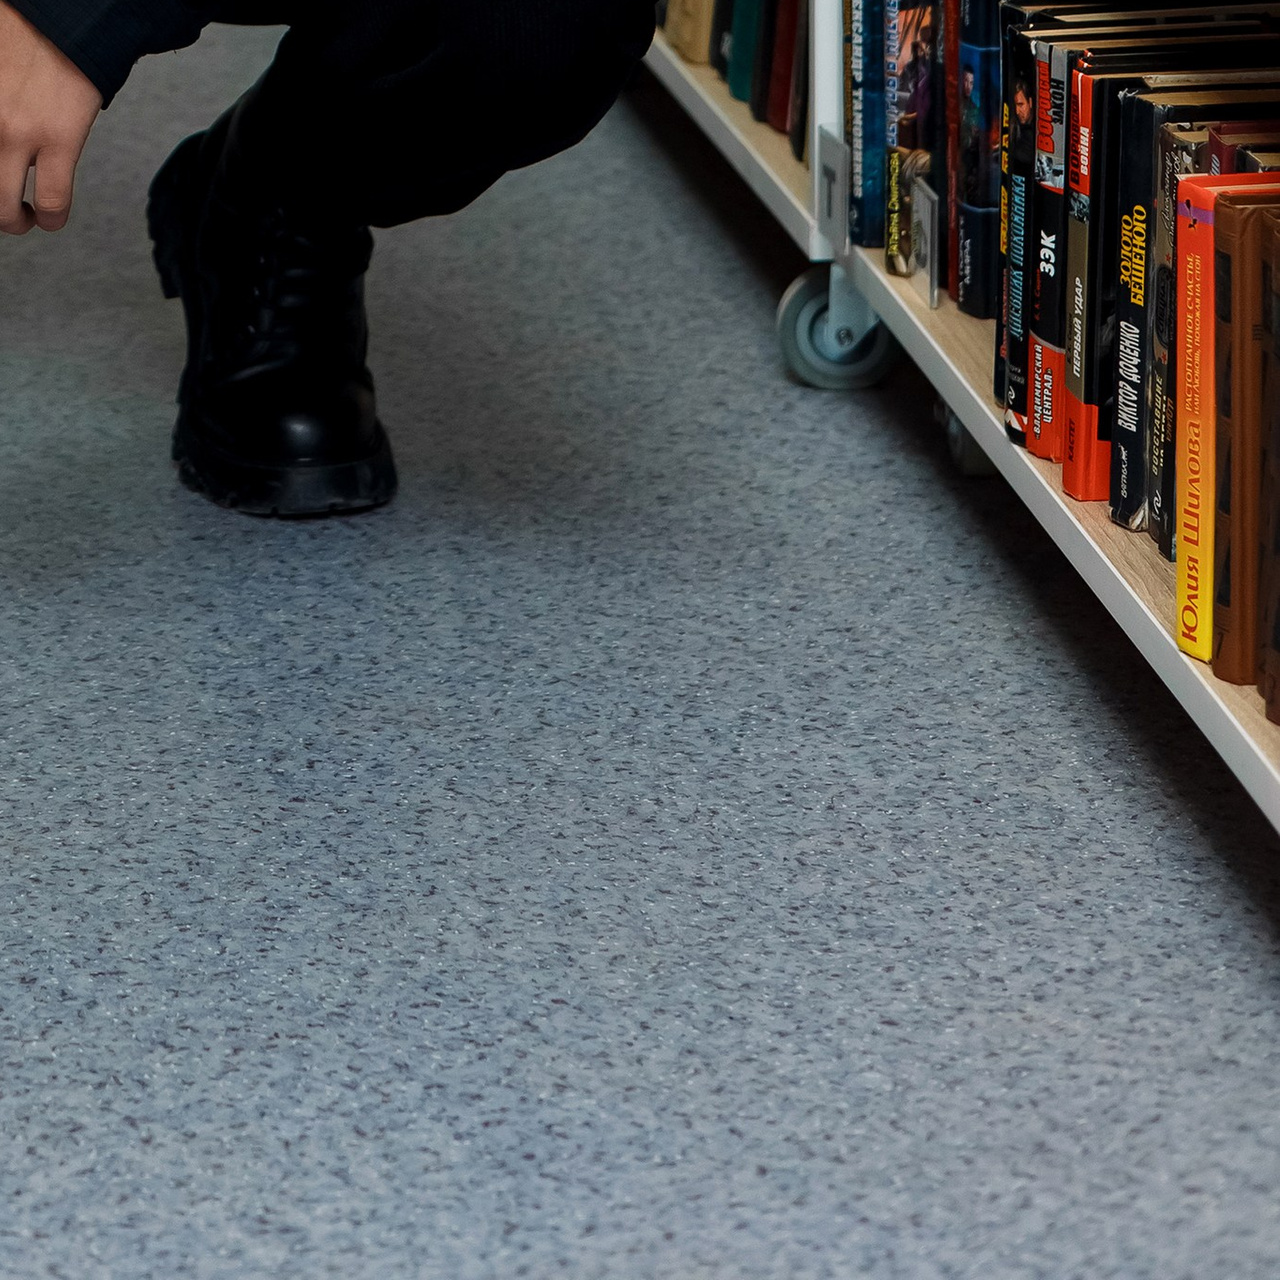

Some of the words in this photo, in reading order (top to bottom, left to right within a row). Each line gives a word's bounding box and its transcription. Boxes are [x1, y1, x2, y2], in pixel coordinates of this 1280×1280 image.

[1035, 58, 1056, 154] ВОРОВСКОЙ
[1049, 79, 1066, 127] ЗАКОН
[1078, 125, 1091, 176] ВОЙНА
[1039, 229, 1057, 278] ЗЭК
[1119, 214, 1133, 289] ЗОЛОТО
[1130, 204, 1148, 307] БЕШЕНОГО
[1185, 252, 1196, 311] СЧАСТЬЕ,
[1073, 276, 1085, 316] УДАР
[1194, 292, 1202, 347] ПОХОЖАЯ
[1072, 316, 1084, 378] ПЕРВЫЙ
[1119, 320, 1142, 383] ДОЦЕНКО
[1184, 311, 1195, 413] РАСТОПТАННОЕ
[1033, 343, 1043, 440] «ВЛАДИМИРСКИЙ
[1042, 368, 1054, 424] ЦЕНТРАЛ»
[1116, 381, 1138, 433] ВИКТОР
[1067, 416, 1077, 464] КАСТЕТ
[1151, 369, 1163, 477] ВОССТАВШИЕ
[1182, 419, 1202, 548] Шилова
[1180, 554, 1200, 645] Юлия
